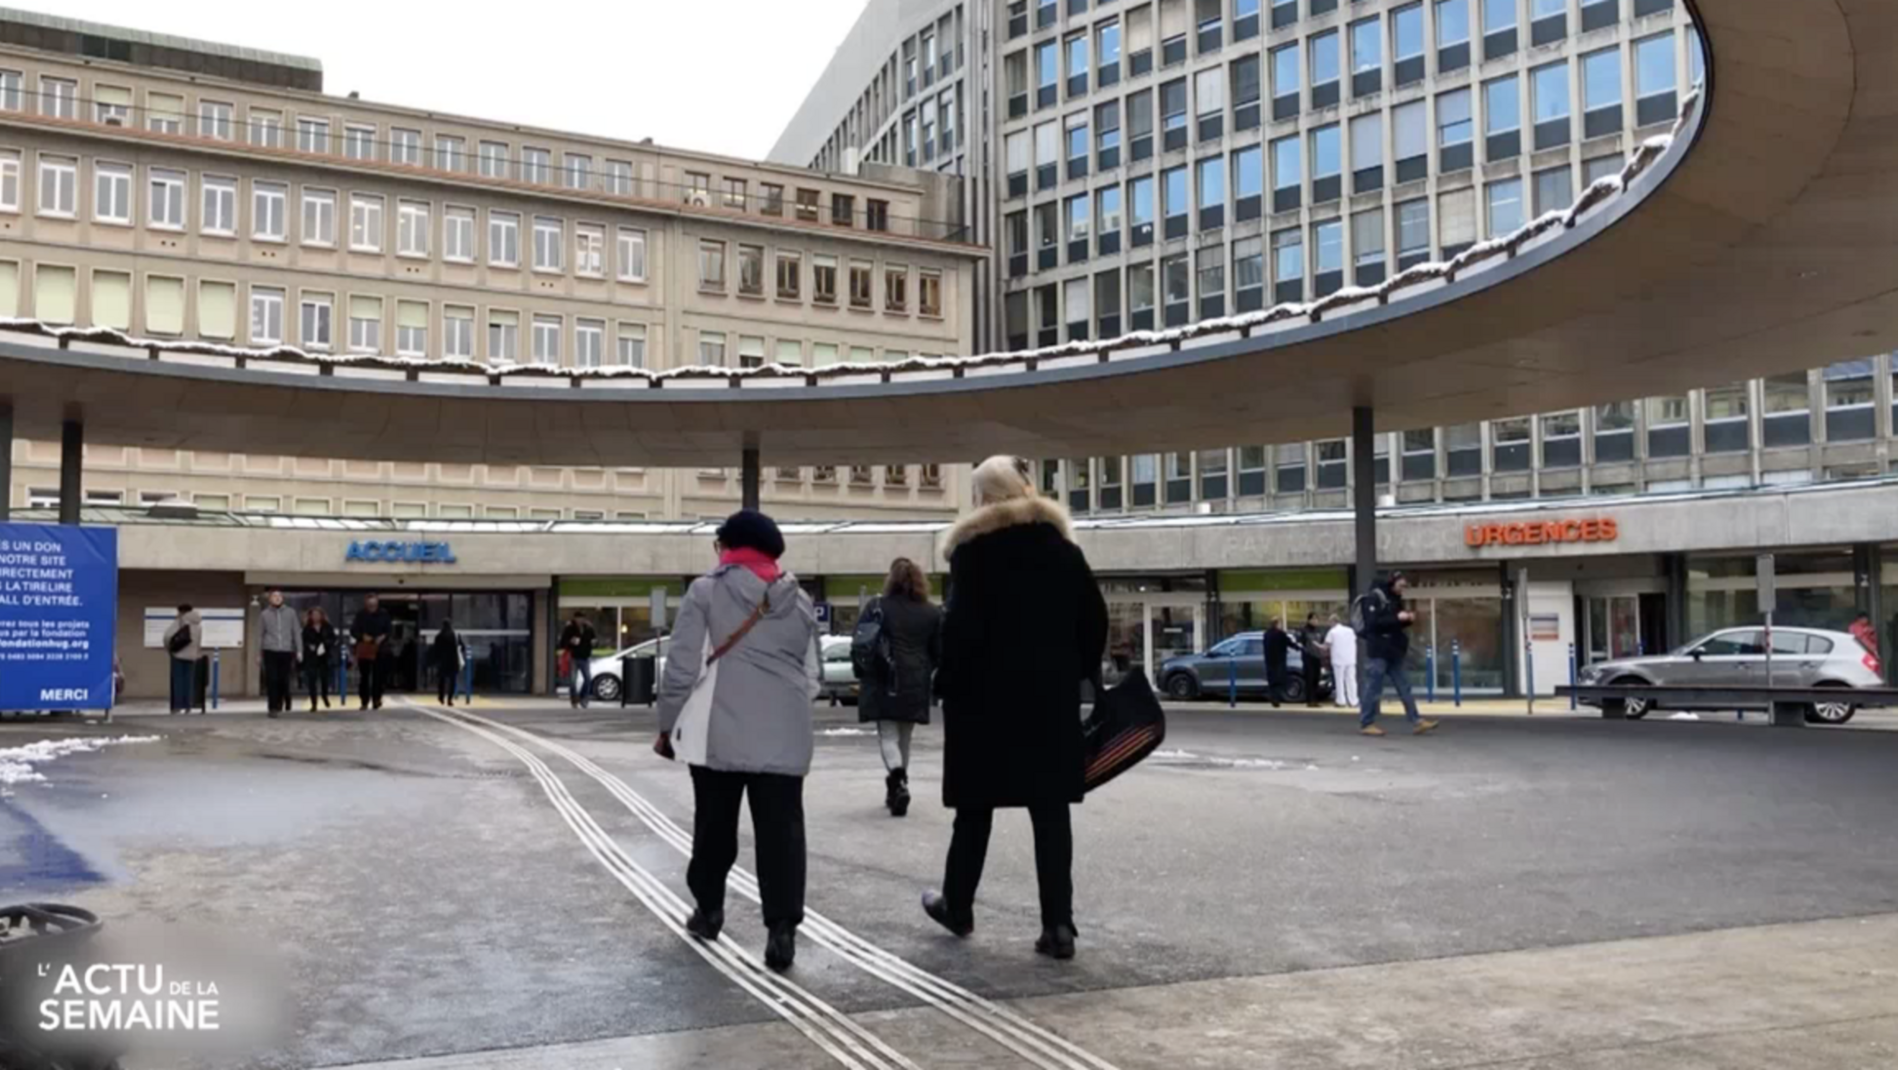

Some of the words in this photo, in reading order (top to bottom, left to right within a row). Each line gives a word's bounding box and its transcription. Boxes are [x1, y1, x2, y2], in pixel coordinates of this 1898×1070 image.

[1465, 518, 1618, 547] URGENCES
[13, 541, 31, 551] UN
[34, 541, 61, 553] DON
[345, 540, 458, 563] ACCUEIL
[41, 555, 66, 566] SITE
[5, 581, 21, 591] LA
[22, 581, 73, 593] TIRELIRE
[18, 620, 39, 628] tous
[41, 619, 55, 628] les
[57, 620, 90, 631] projets
[12, 630, 28, 639] par
[41, 629, 87, 638] fondation
[40, 688, 88, 701] MERCI
